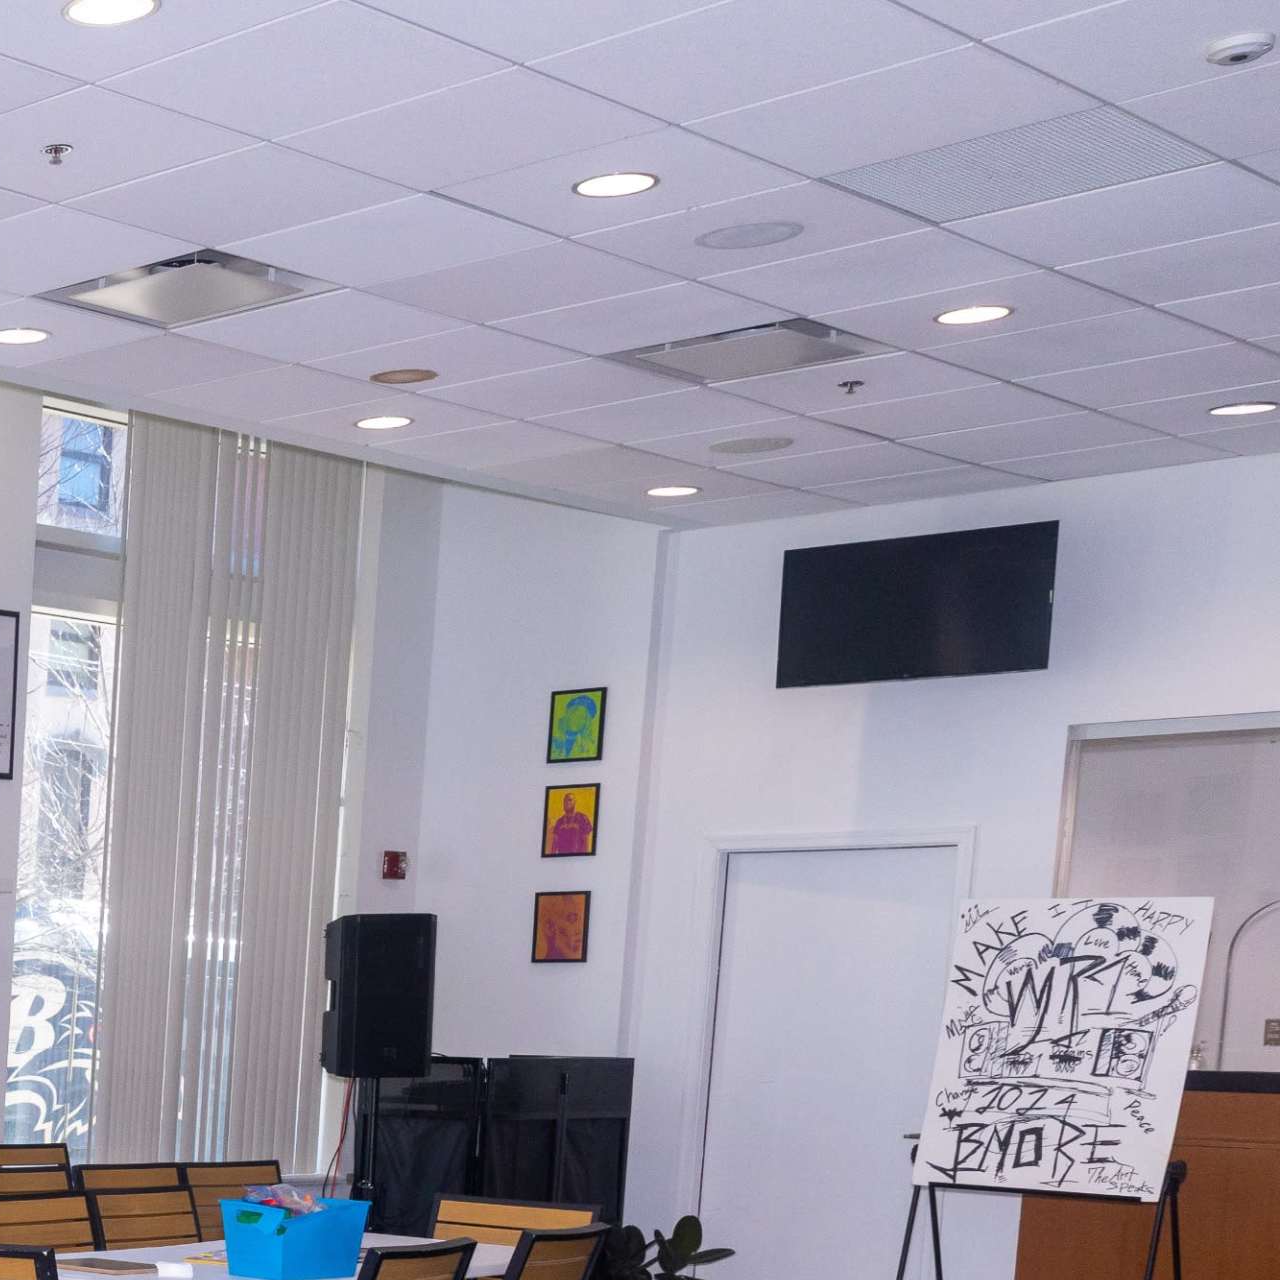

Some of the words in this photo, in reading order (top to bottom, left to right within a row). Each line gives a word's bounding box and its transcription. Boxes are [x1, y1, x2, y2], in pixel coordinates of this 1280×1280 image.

[951, 909, 1029, 998] MAKE
[1134, 900, 1196, 936] HAPPY
[1083, 935, 1111, 950] Love
[935, 1086, 980, 1108] Change
[1123, 1099, 1157, 1135] Peace
[940, 1114, 1128, 1186] BMORE
[1088, 1165, 1109, 1185] The
[1110, 1167, 1139, 1182] Art
[1106, 1182, 1156, 1196] Speaks
